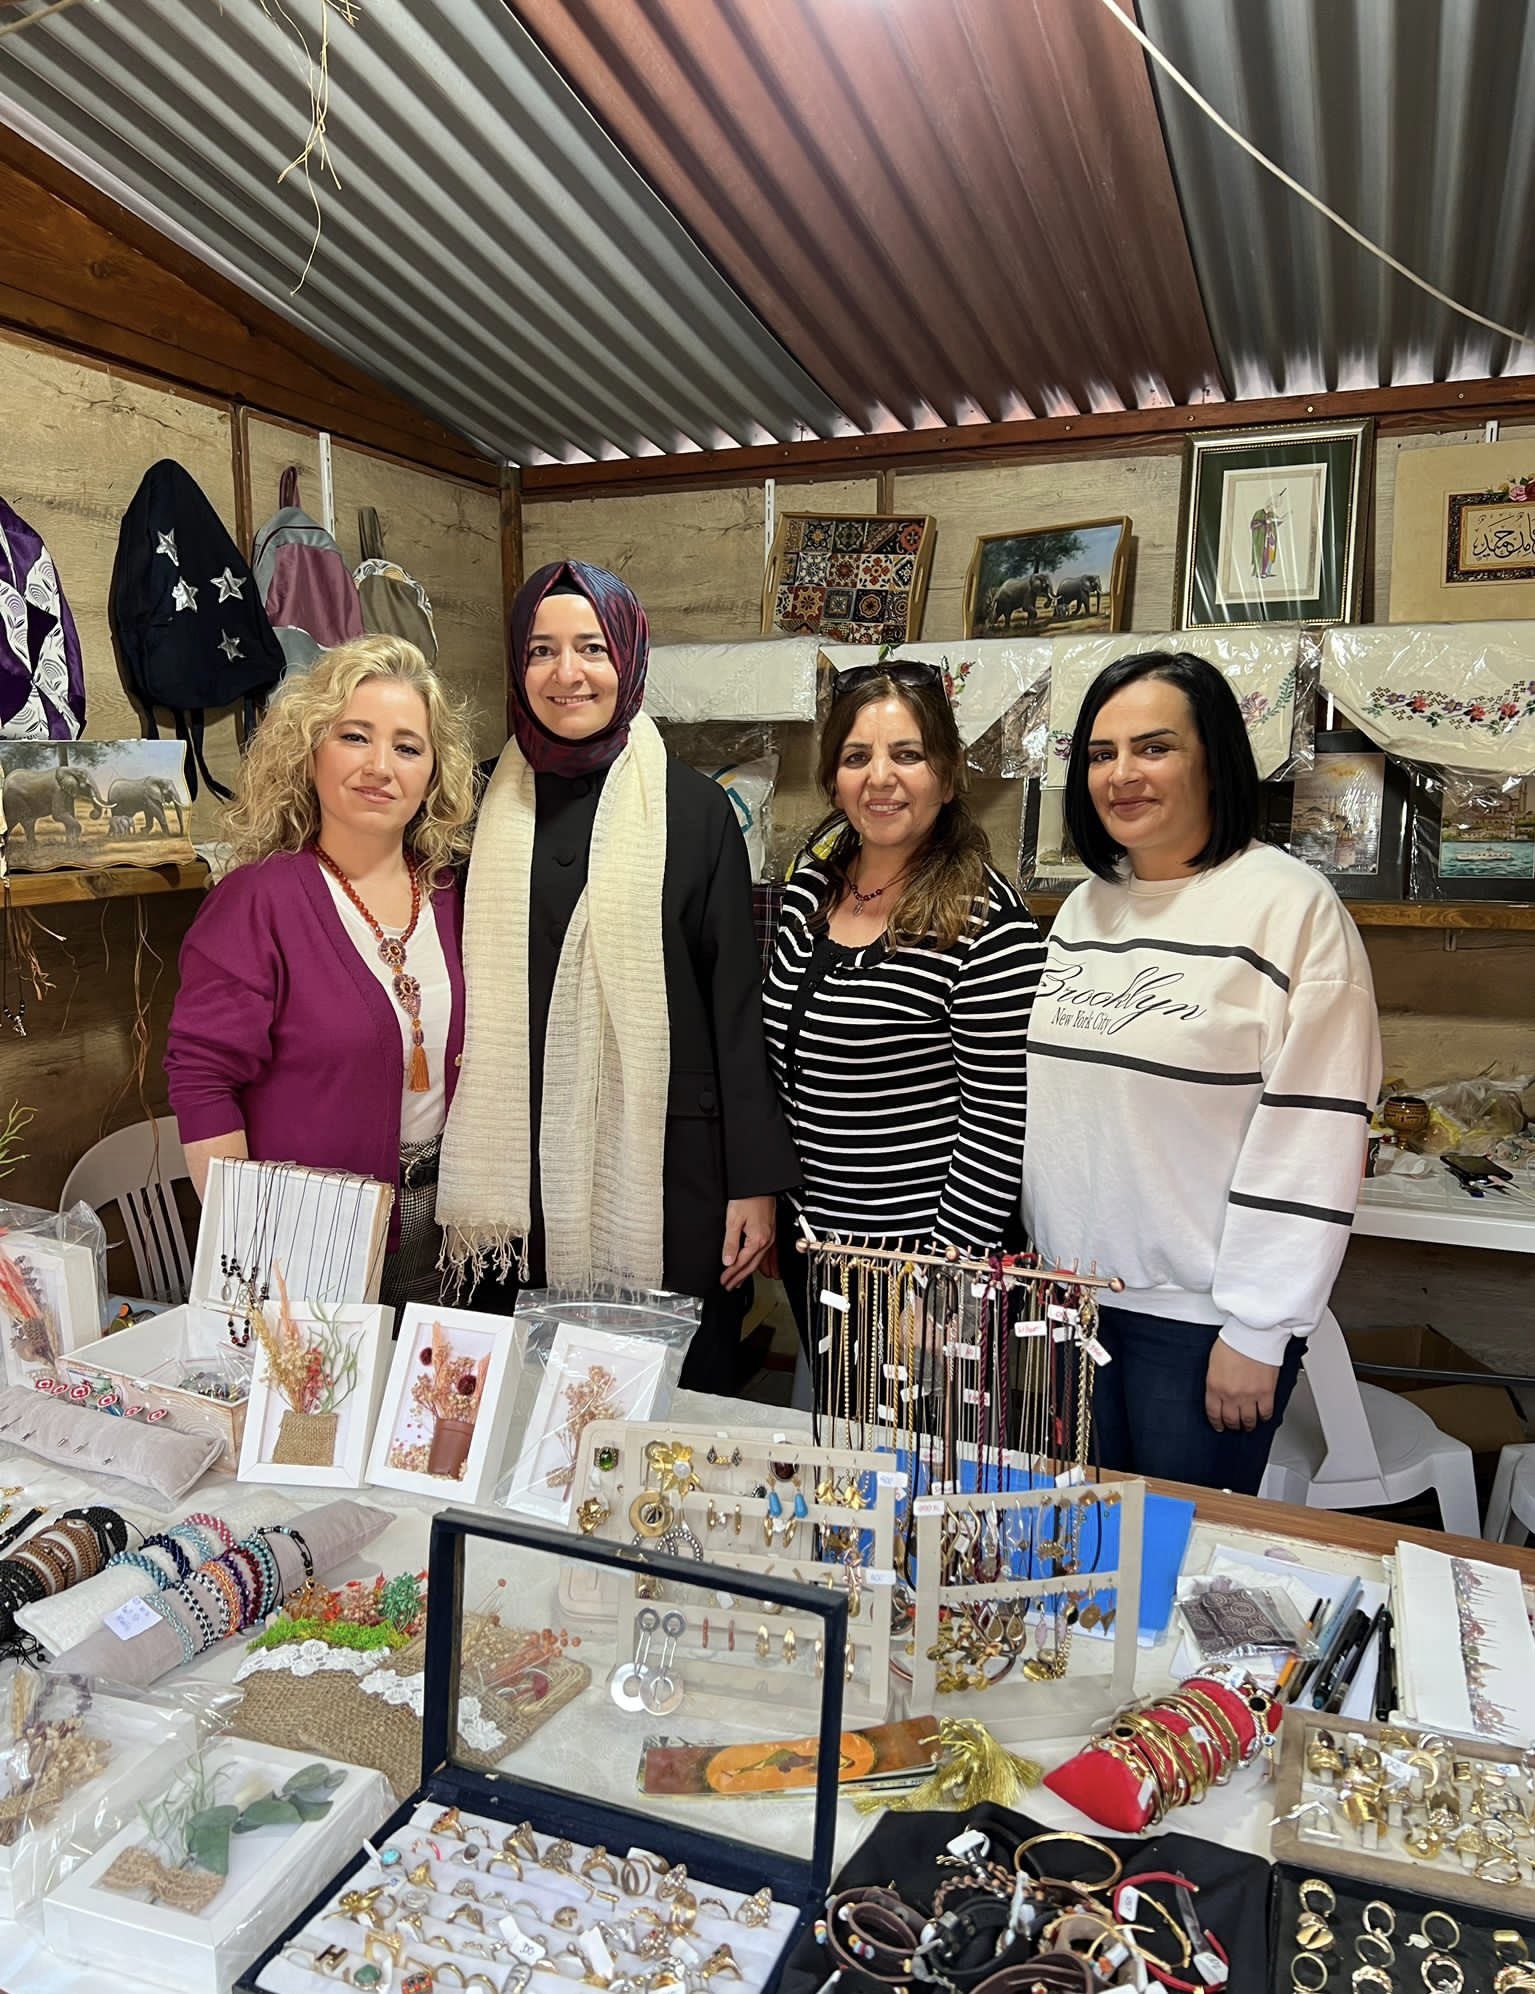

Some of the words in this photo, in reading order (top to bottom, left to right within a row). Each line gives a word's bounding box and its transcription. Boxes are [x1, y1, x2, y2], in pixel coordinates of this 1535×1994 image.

[1036, 957, 1207, 1035] Brooklyn
[1051, 1007, 1073, 1026] New
[1073, 1009, 1094, 1029] York
[1092, 1012, 1112, 1035] City
